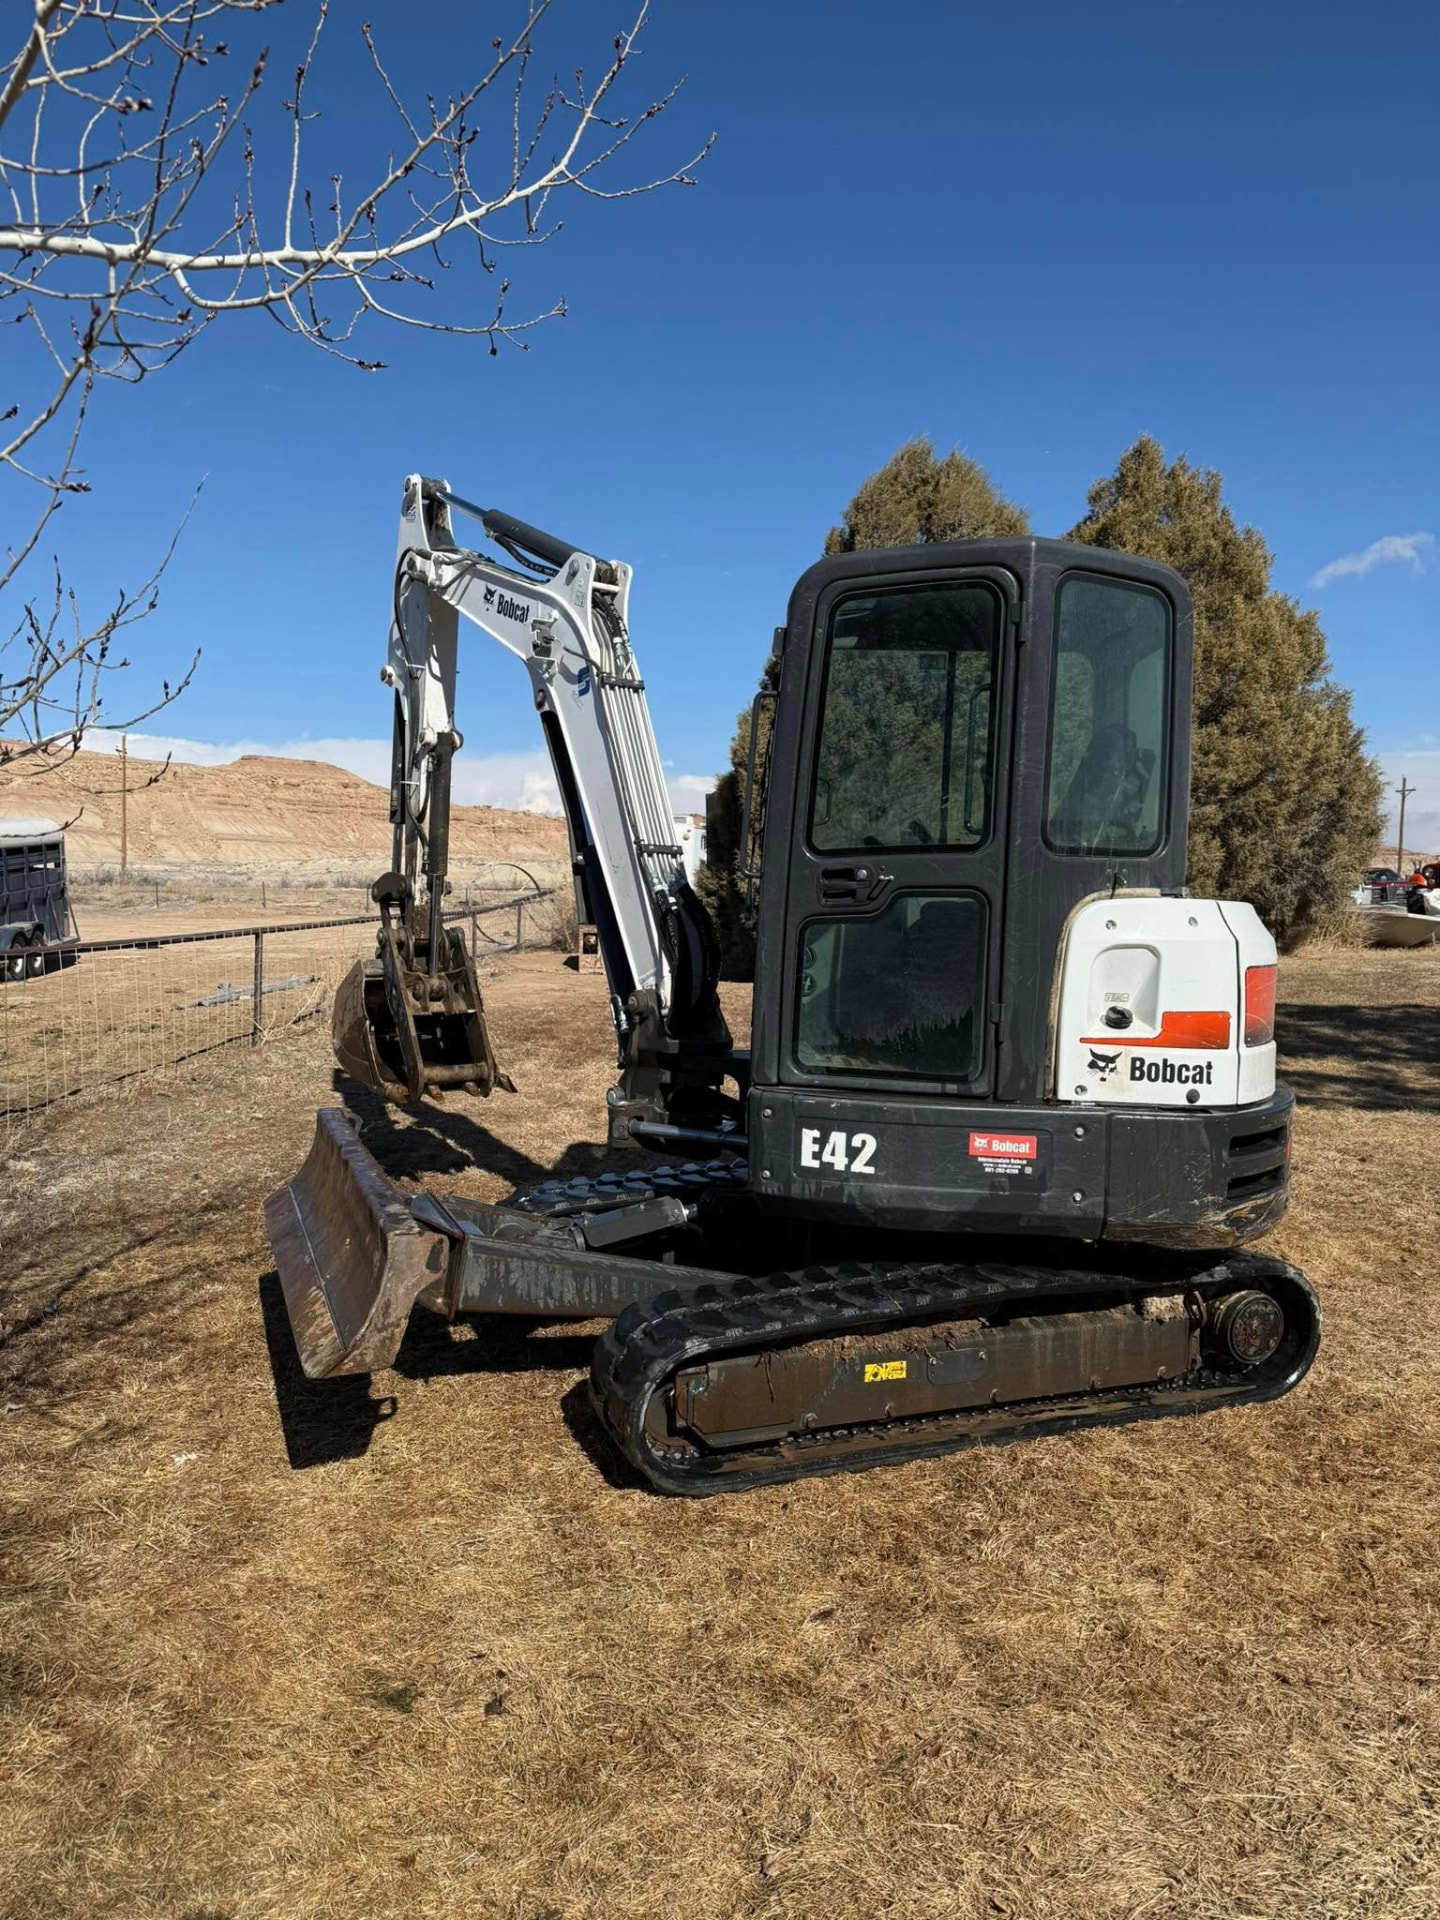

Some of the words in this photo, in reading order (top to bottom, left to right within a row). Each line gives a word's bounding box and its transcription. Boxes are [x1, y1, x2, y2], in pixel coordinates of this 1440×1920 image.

[497, 593, 530, 623] Bobcat
[1129, 1056, 1213, 1085] Bobcat
[800, 1127, 877, 1175] E42
[991, 1139, 1030, 1154] Bobcat
